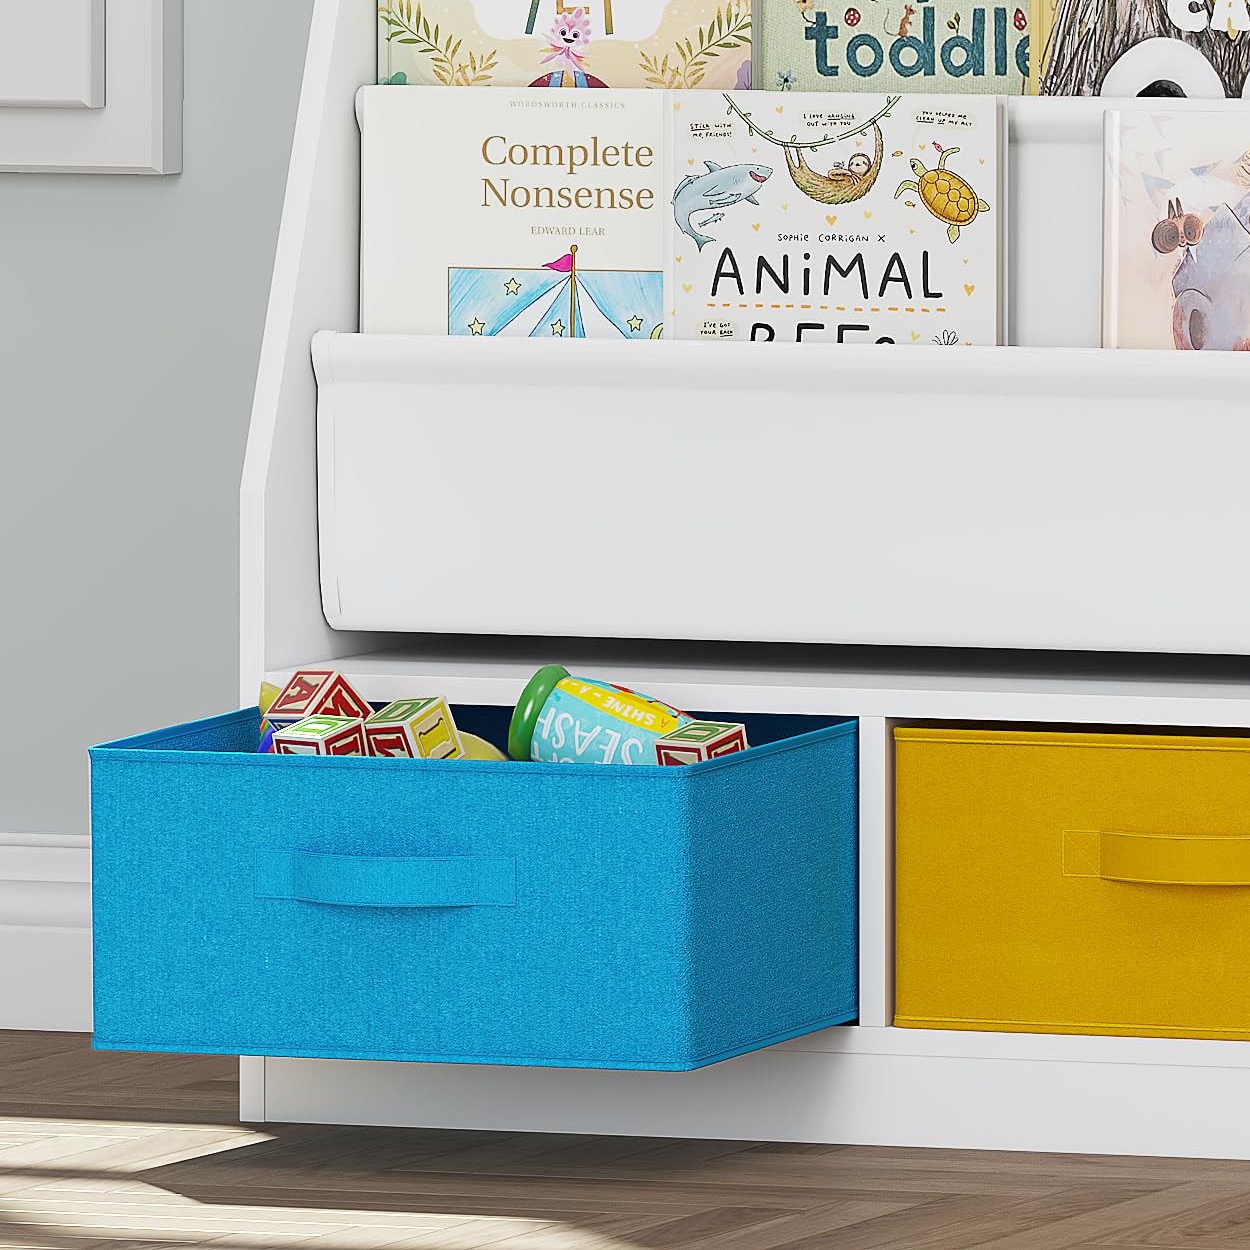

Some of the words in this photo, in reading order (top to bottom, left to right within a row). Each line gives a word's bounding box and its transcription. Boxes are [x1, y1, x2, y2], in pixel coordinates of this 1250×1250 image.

[510, 101, 577, 109] WORDSWORTH
[481, 135, 654, 174] Complete
[481, 178, 654, 210] Nonsense
[531, 226, 576, 236] EDWARD
[579, 226, 606, 236] LEAR
